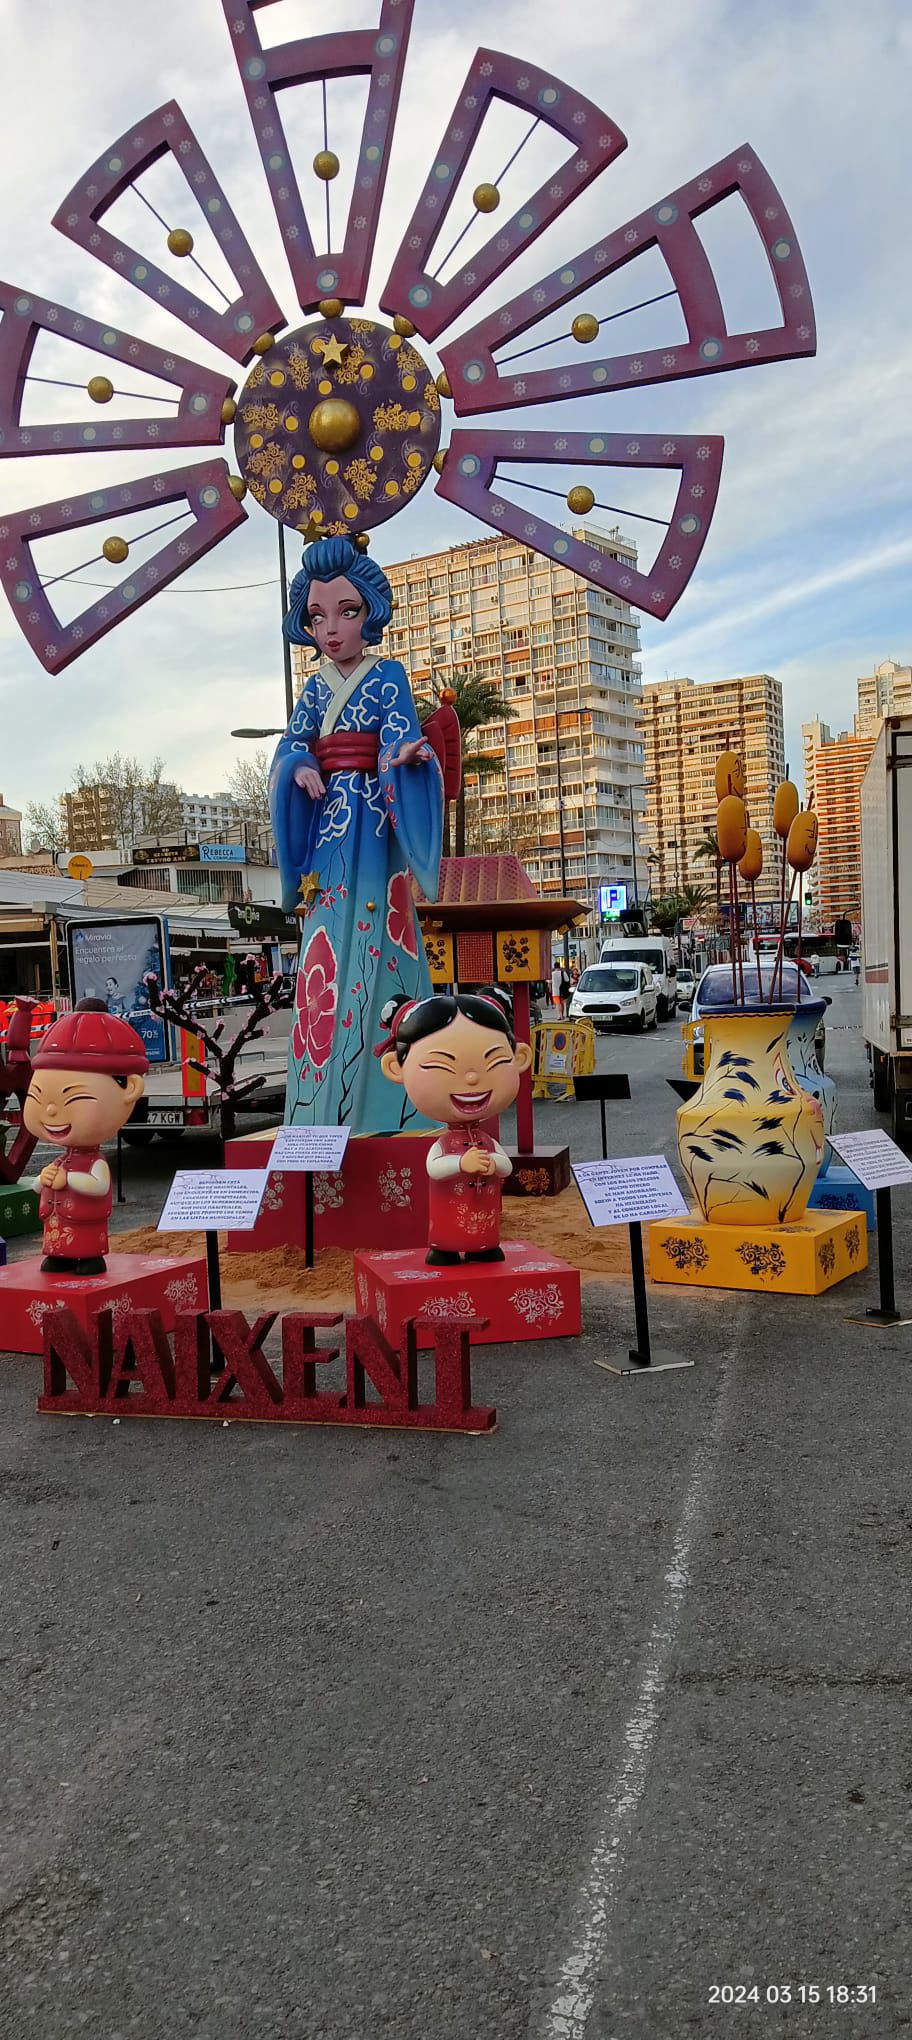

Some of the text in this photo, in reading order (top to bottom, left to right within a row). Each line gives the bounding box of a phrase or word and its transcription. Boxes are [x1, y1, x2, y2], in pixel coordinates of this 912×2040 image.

[202, 846, 233, 859] REBECCA
[85, 934, 112, 942] Miravia
[75, 944, 124, 955] Encuentra el
[76, 954, 137, 965] regalo perfecto
[42, 1308, 490, 1410] NAIXENT
